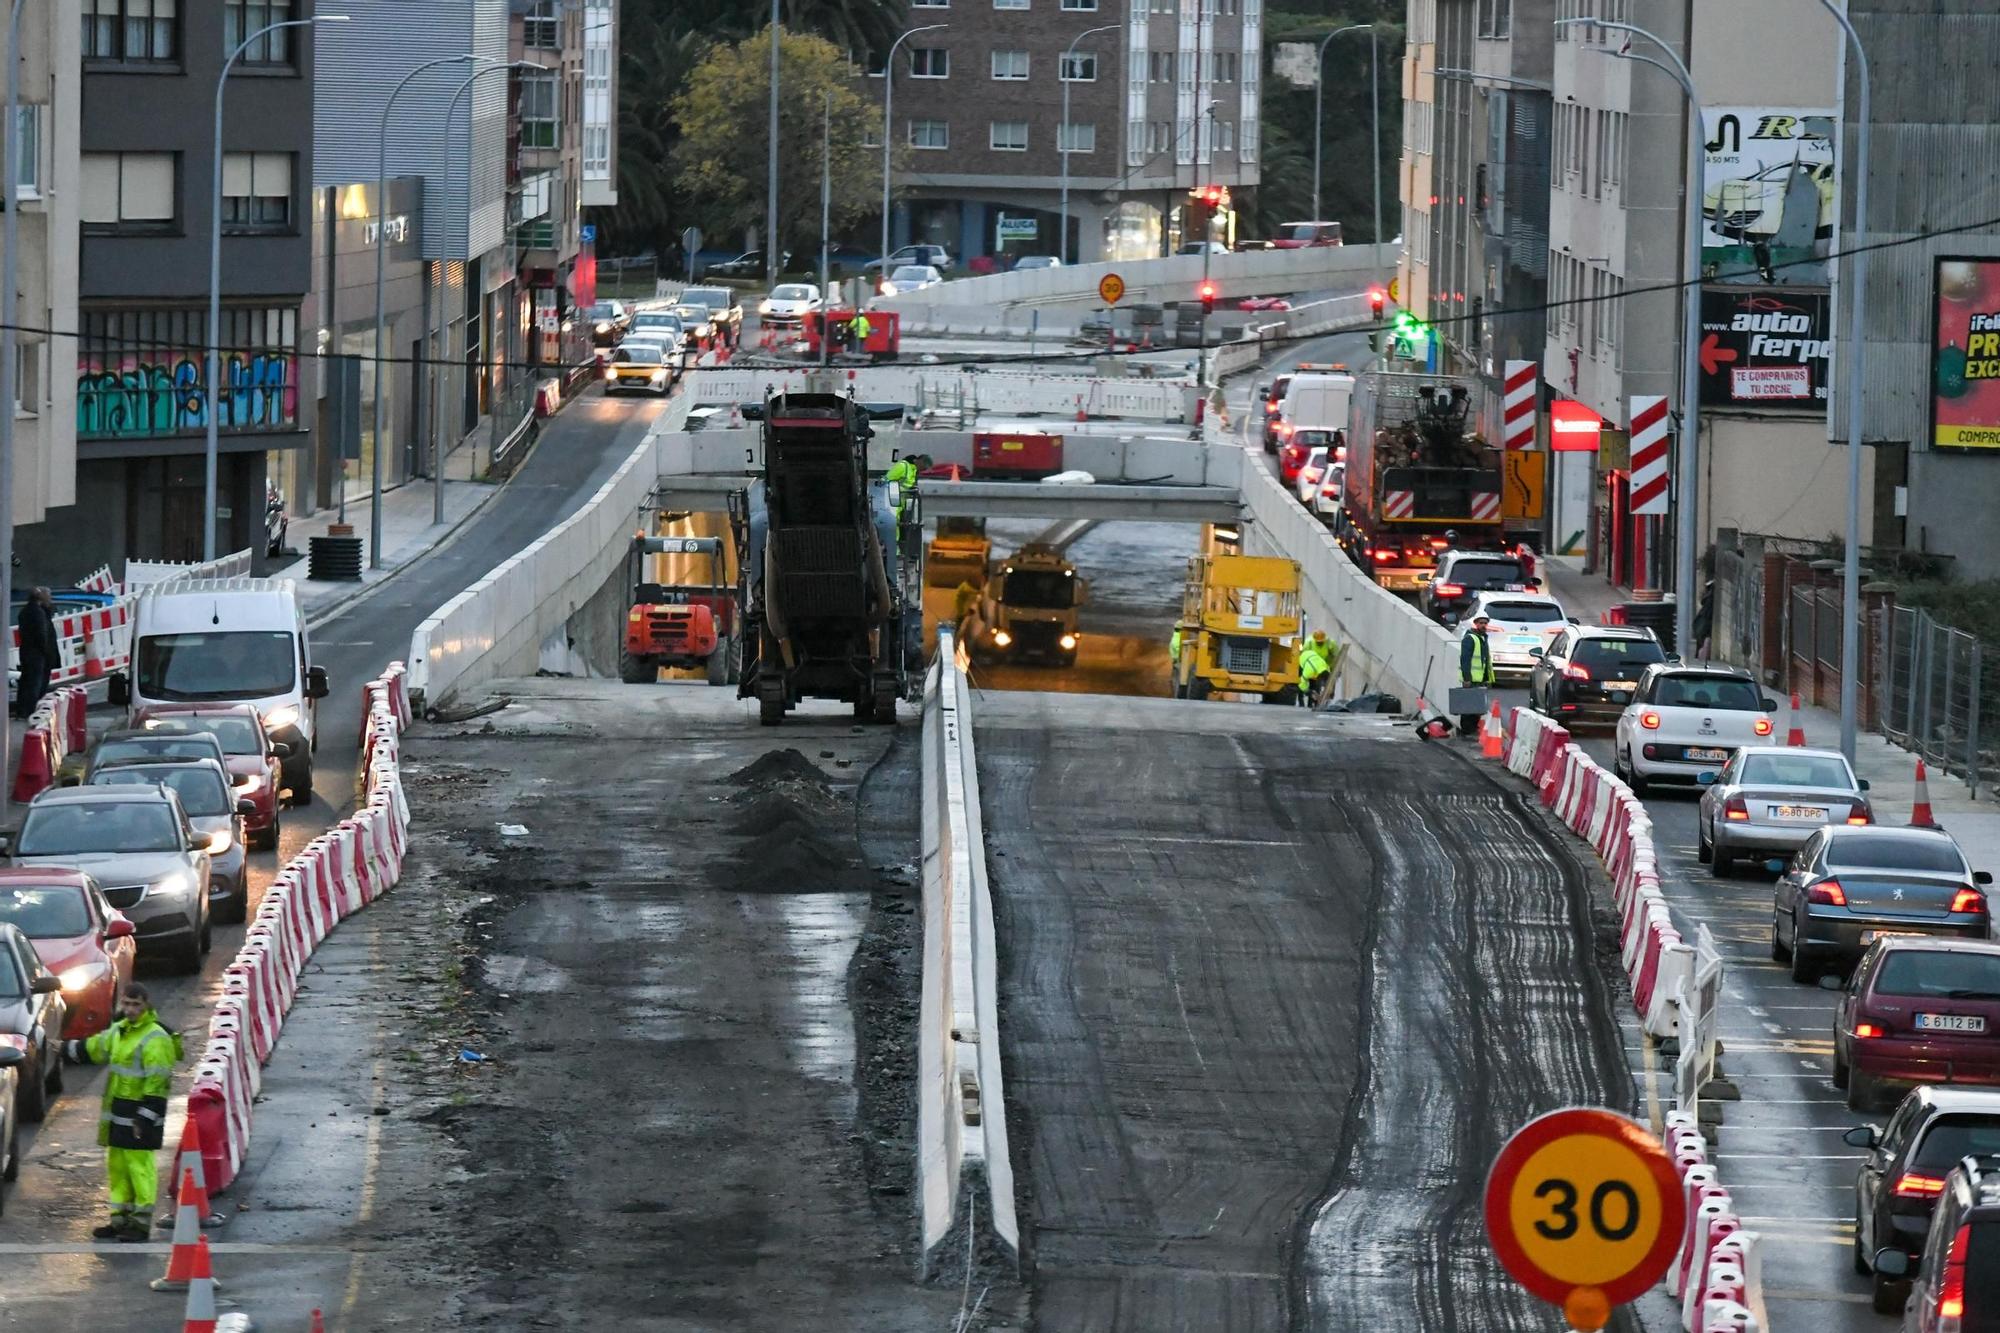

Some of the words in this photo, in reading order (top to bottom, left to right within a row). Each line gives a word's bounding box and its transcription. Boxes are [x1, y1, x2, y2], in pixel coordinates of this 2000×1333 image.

[1731, 311, 1809, 333] auto
[1967, 333, 2000, 357] PR
[1736, 371, 1746, 381] TE
[1748, 371, 1806, 382] COMPRAMOS
[1965, 360, 2000, 378] EXC
[1750, 384, 1760, 394] TU
[1763, 384, 1792, 394] COCHE
[1922, 1016, 1930, 1027] C
[1933, 1016, 1963, 1029] 6112
[1967, 1018, 1983, 1030] BW
[1533, 1179, 1640, 1242] 30
